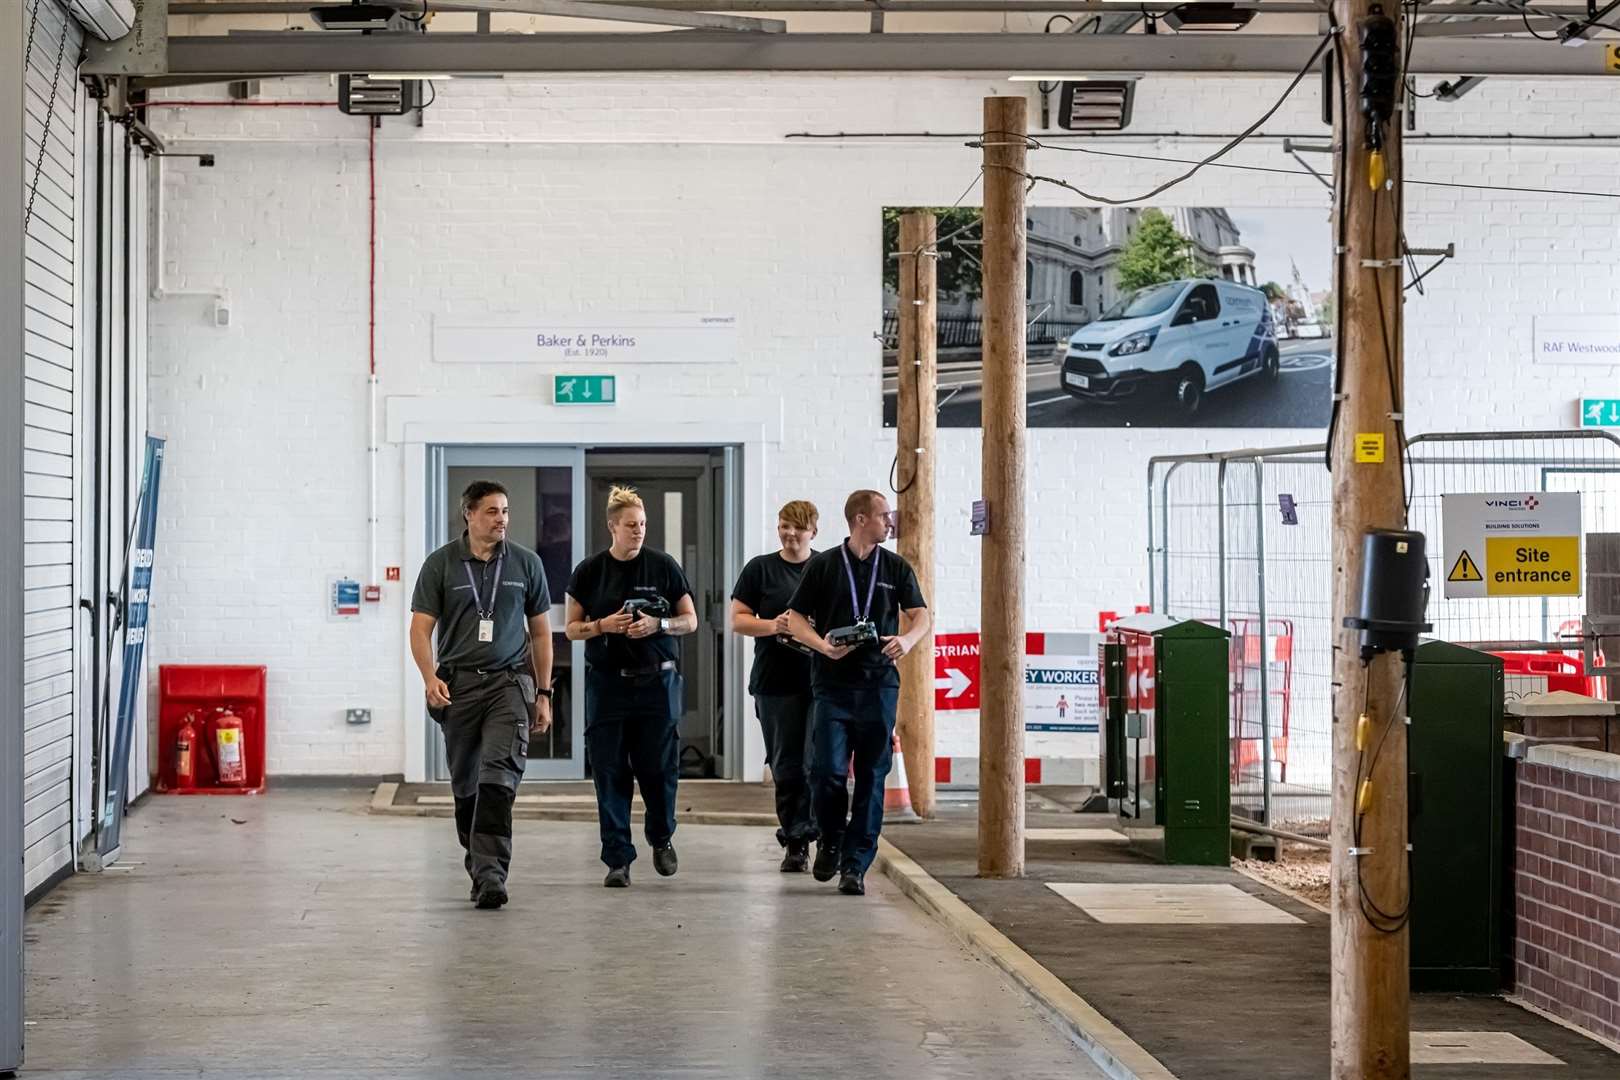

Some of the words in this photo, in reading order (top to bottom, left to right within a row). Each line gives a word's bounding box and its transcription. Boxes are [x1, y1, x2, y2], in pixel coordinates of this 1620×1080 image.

[537, 334, 572, 347] Baker
[576, 334, 586, 347] &
[591, 334, 636, 347] Perkins
[1543, 342, 1564, 353] RAF
[1515, 547, 1550, 563] Site
[1494, 568, 1571, 583] entrance
[1041, 671, 1098, 684] WORKER
